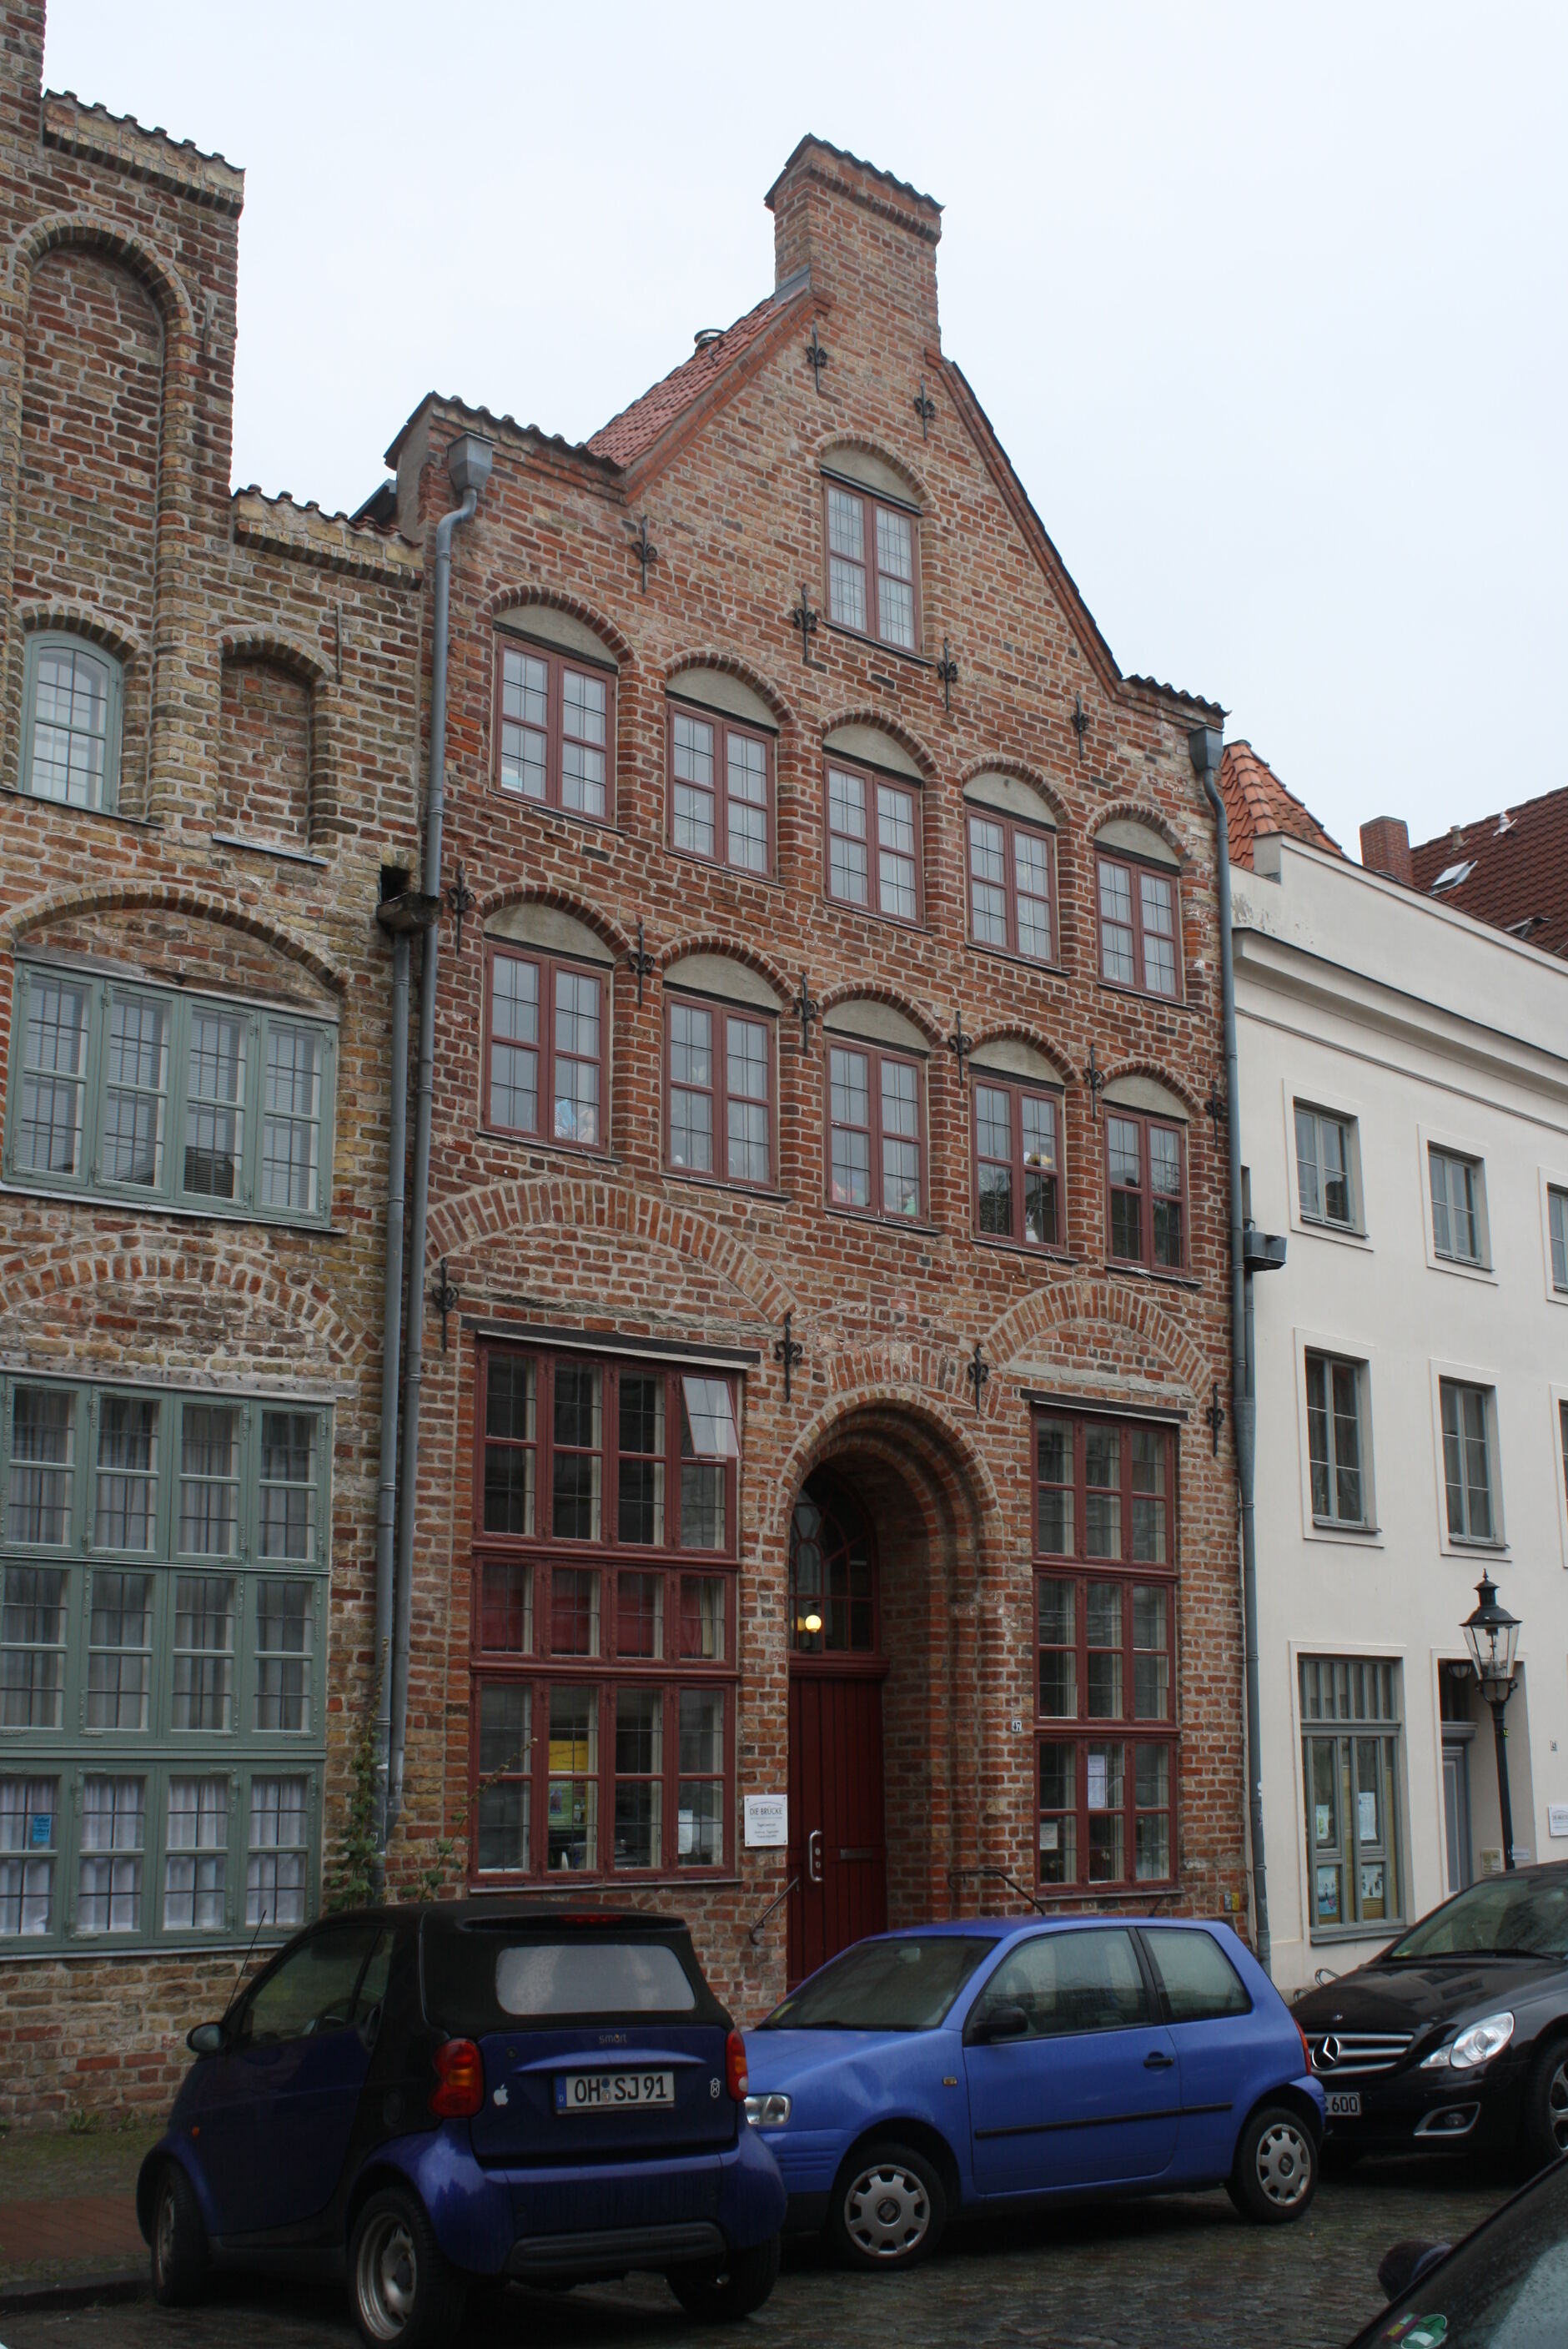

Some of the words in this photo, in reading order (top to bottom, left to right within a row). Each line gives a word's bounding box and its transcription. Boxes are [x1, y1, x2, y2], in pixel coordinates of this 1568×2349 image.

[761, 1806, 782, 1815] BRÜCKE
[599, 2034, 627, 2043] smart
[575, 2079, 601, 2102] OH
[1332, 2096, 1358, 2112] 600
